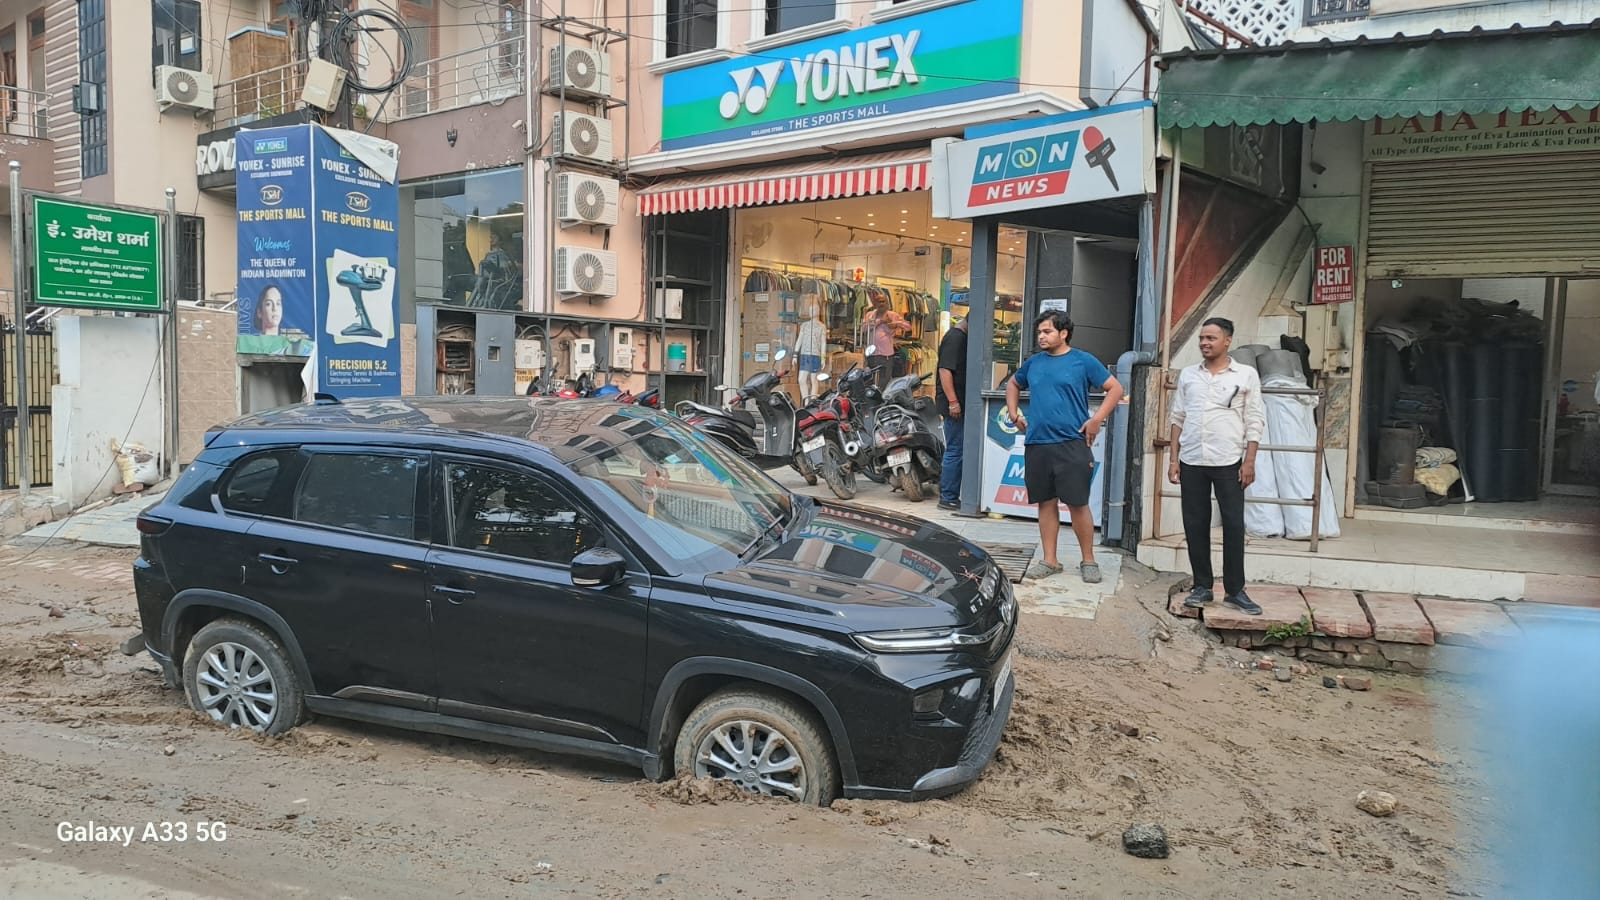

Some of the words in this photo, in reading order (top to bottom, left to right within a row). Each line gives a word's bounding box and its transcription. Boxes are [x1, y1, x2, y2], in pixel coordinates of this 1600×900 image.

[790, 30, 920, 105] YONEX
[788, 118, 809, 130] THE
[811, 110, 854, 126] SPORTS
[857, 103, 889, 119] MALL
[1402, 134, 1468, 145] Manufacturer
[1471, 131, 1482, 141] of
[1484, 131, 1503, 140] Eva
[1506, 127, 1564, 138] Lamination
[1387, 147, 1407, 157] Type
[1410, 145, 1420, 153] of
[1465, 142, 1493, 151] Foam
[1496, 140, 1529, 149] Fabric
[1531, 139, 1540, 147] &
[1544, 138, 1564, 146] Eva
[1567, 136, 1590, 145] Foot
[239, 159, 264, 172] YONEX
[271, 156, 305, 170] SUNRISE
[321, 158, 350, 175] YONEX
[986, 177, 1049, 201] NEWS
[348, 195, 368, 208] TSM
[239, 210, 254, 222] THE
[255, 208, 284, 221] SPORTS
[285, 208, 306, 219] MALL
[321, 210, 338, 223] THE
[340, 213, 371, 229] SPORTS
[373, 218, 395, 232] MALL
[71, 224, 113, 243] उमेश
[117, 231, 150, 247] शर्मा
[250, 258, 263, 268] THE
[263, 258, 286, 268] QUEEN
[287, 257, 297, 267] OF
[1320, 247, 1346, 266] FOR
[241, 269, 265, 278] INDIAN
[265, 268, 306, 278] BADMINTON
[1317, 267, 1350, 286] RENT
[329, 359, 373, 370] PRECISION
[374, 360, 387, 370] 5.2
